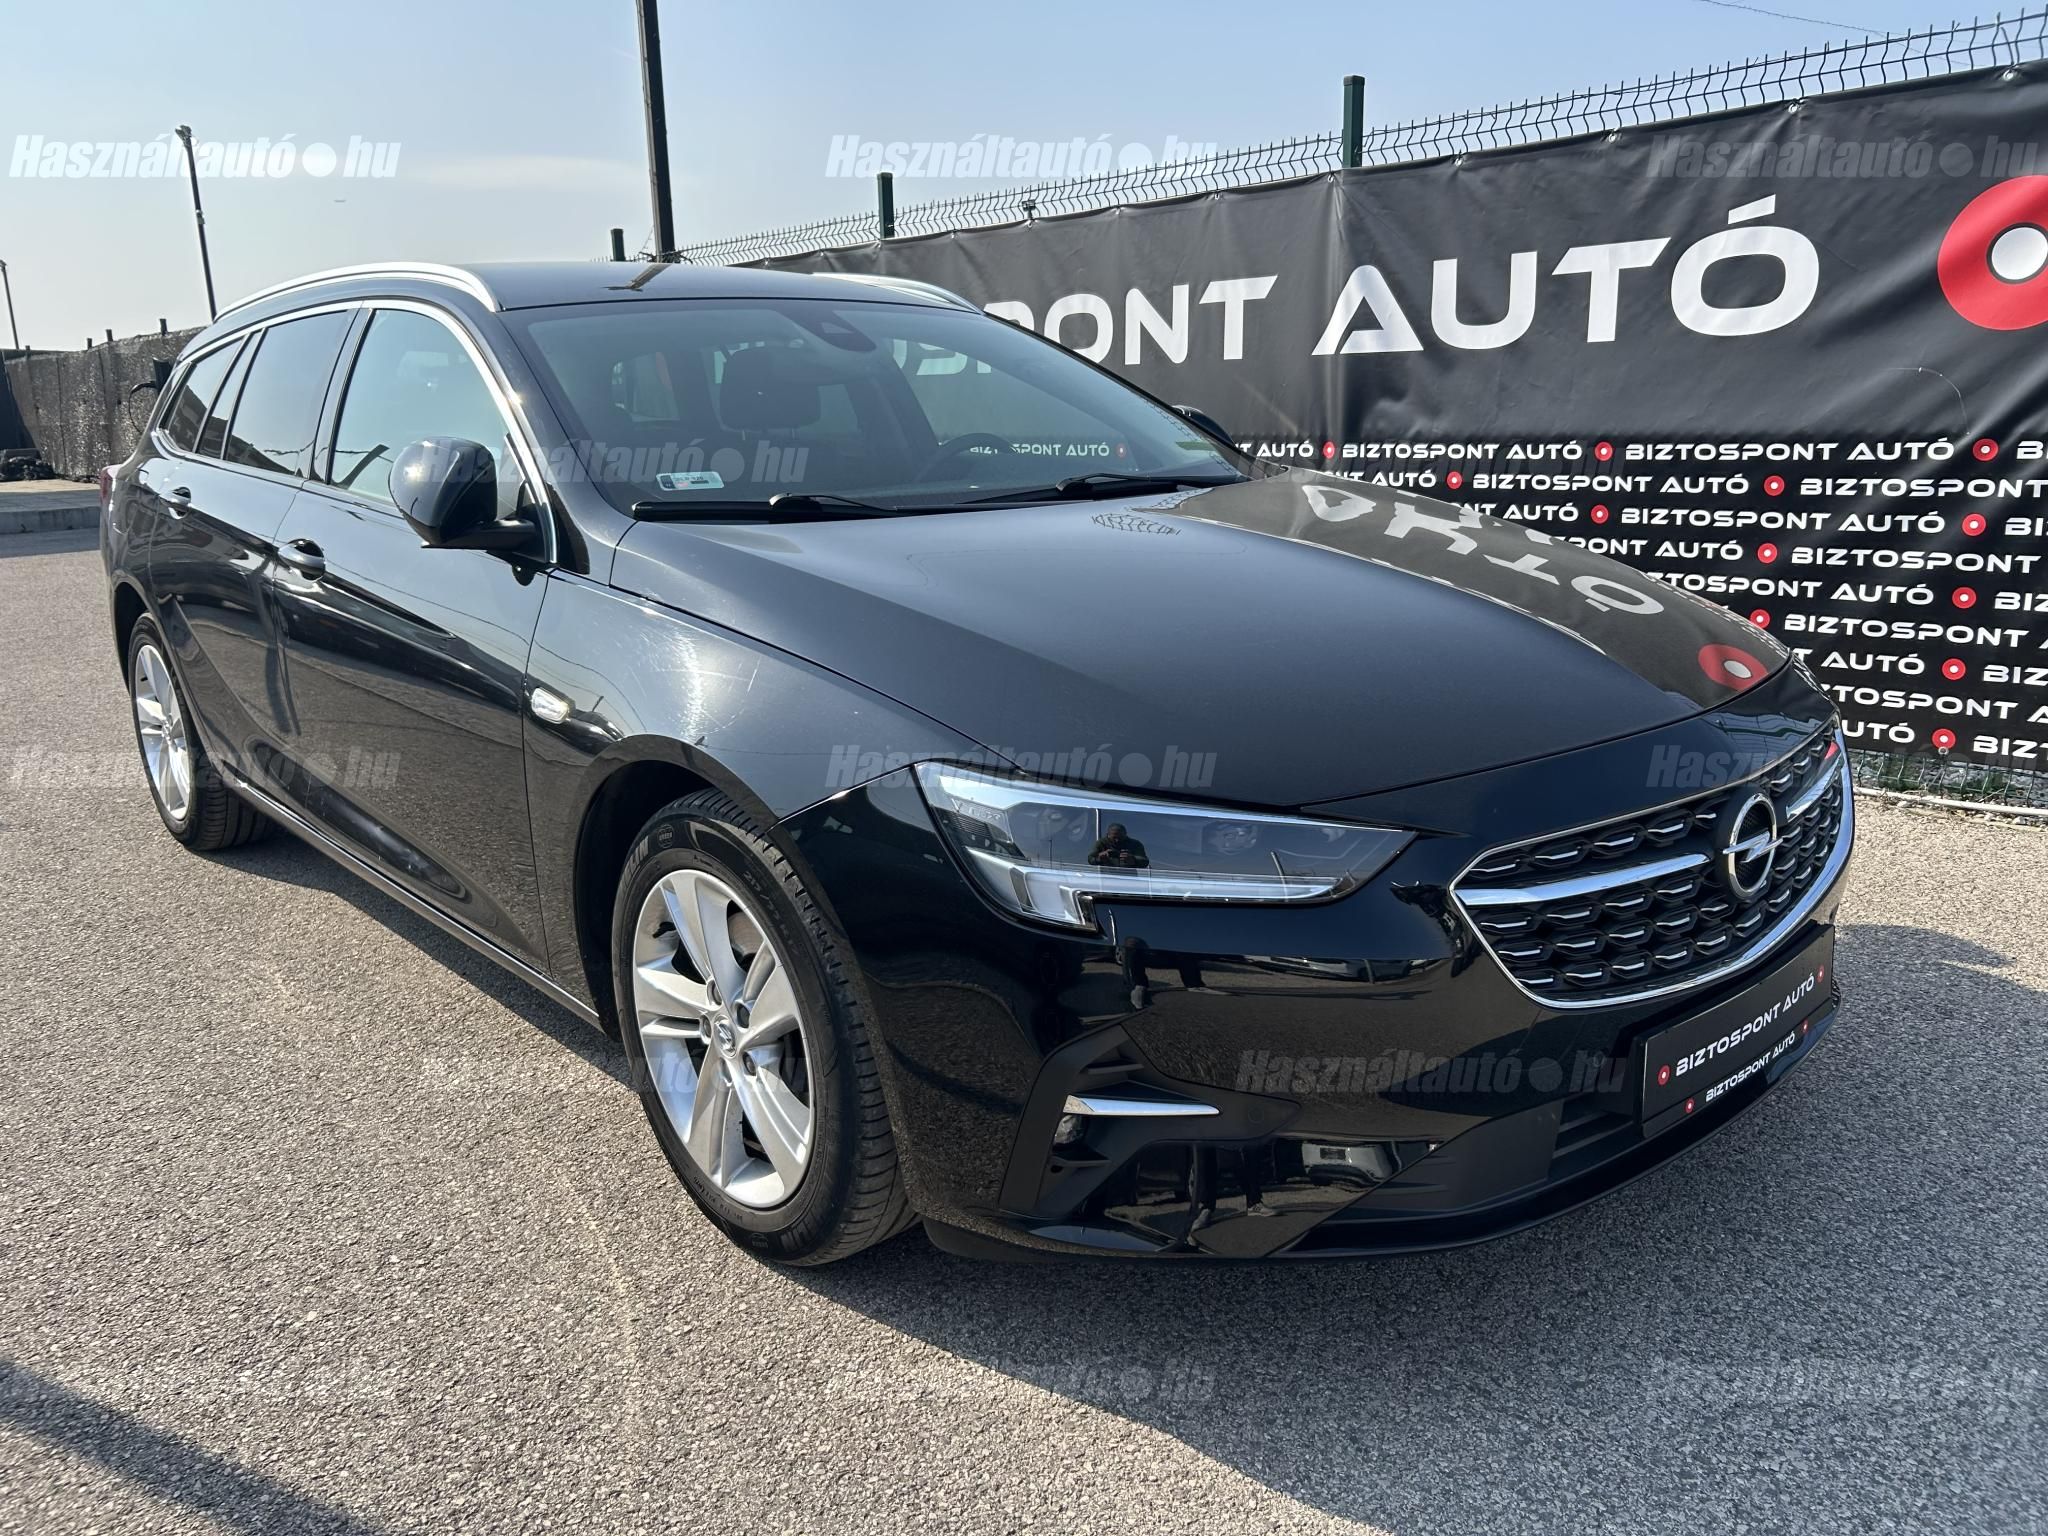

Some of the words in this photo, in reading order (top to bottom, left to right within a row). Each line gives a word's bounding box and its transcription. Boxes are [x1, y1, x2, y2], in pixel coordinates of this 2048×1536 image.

[1311, 194, 1819, 357] AUTÓ
[1065, 441, 1110, 457] AUTÓ
[1256, 441, 1314, 458] AUTÓ
[1342, 443, 1499, 460] BIZTOSPONT
[1505, 441, 1582, 461] AUTÓ
[1626, 443, 1838, 461] BIZTOSPONT
[1846, 438, 1955, 462] AUTÓ
[1371, 470, 1437, 489] AUTÓ
[1472, 473, 1653, 493] BIZTOSPONT
[1659, 474, 1749, 495] AUTÓ
[1800, 478, 2048, 499] BIZTOSPONT
[1502, 501, 1579, 522] AUTÓ
[1622, 507, 1832, 531] BIZTOSPONT
[1838, 511, 1946, 535] AUTÓ
[1654, 539, 1743, 561] AUTÓ
[1791, 546, 2042, 575] BIZTOSPONT
[1830, 583, 1935, 606] AUTÓ
[1784, 613, 2030, 649] BIZTOSPONT
[1821, 653, 1926, 675] AUTÓ
[1983, 664, 2048, 687] BIZ
[1676, 1002, 1781, 1077] BIZTOSPONT
[1782, 972, 1815, 1012] AUTÓ
[1705, 1054, 1771, 1102] BIZTOSPONT
[1772, 1031, 1796, 1060] AUTÓ
